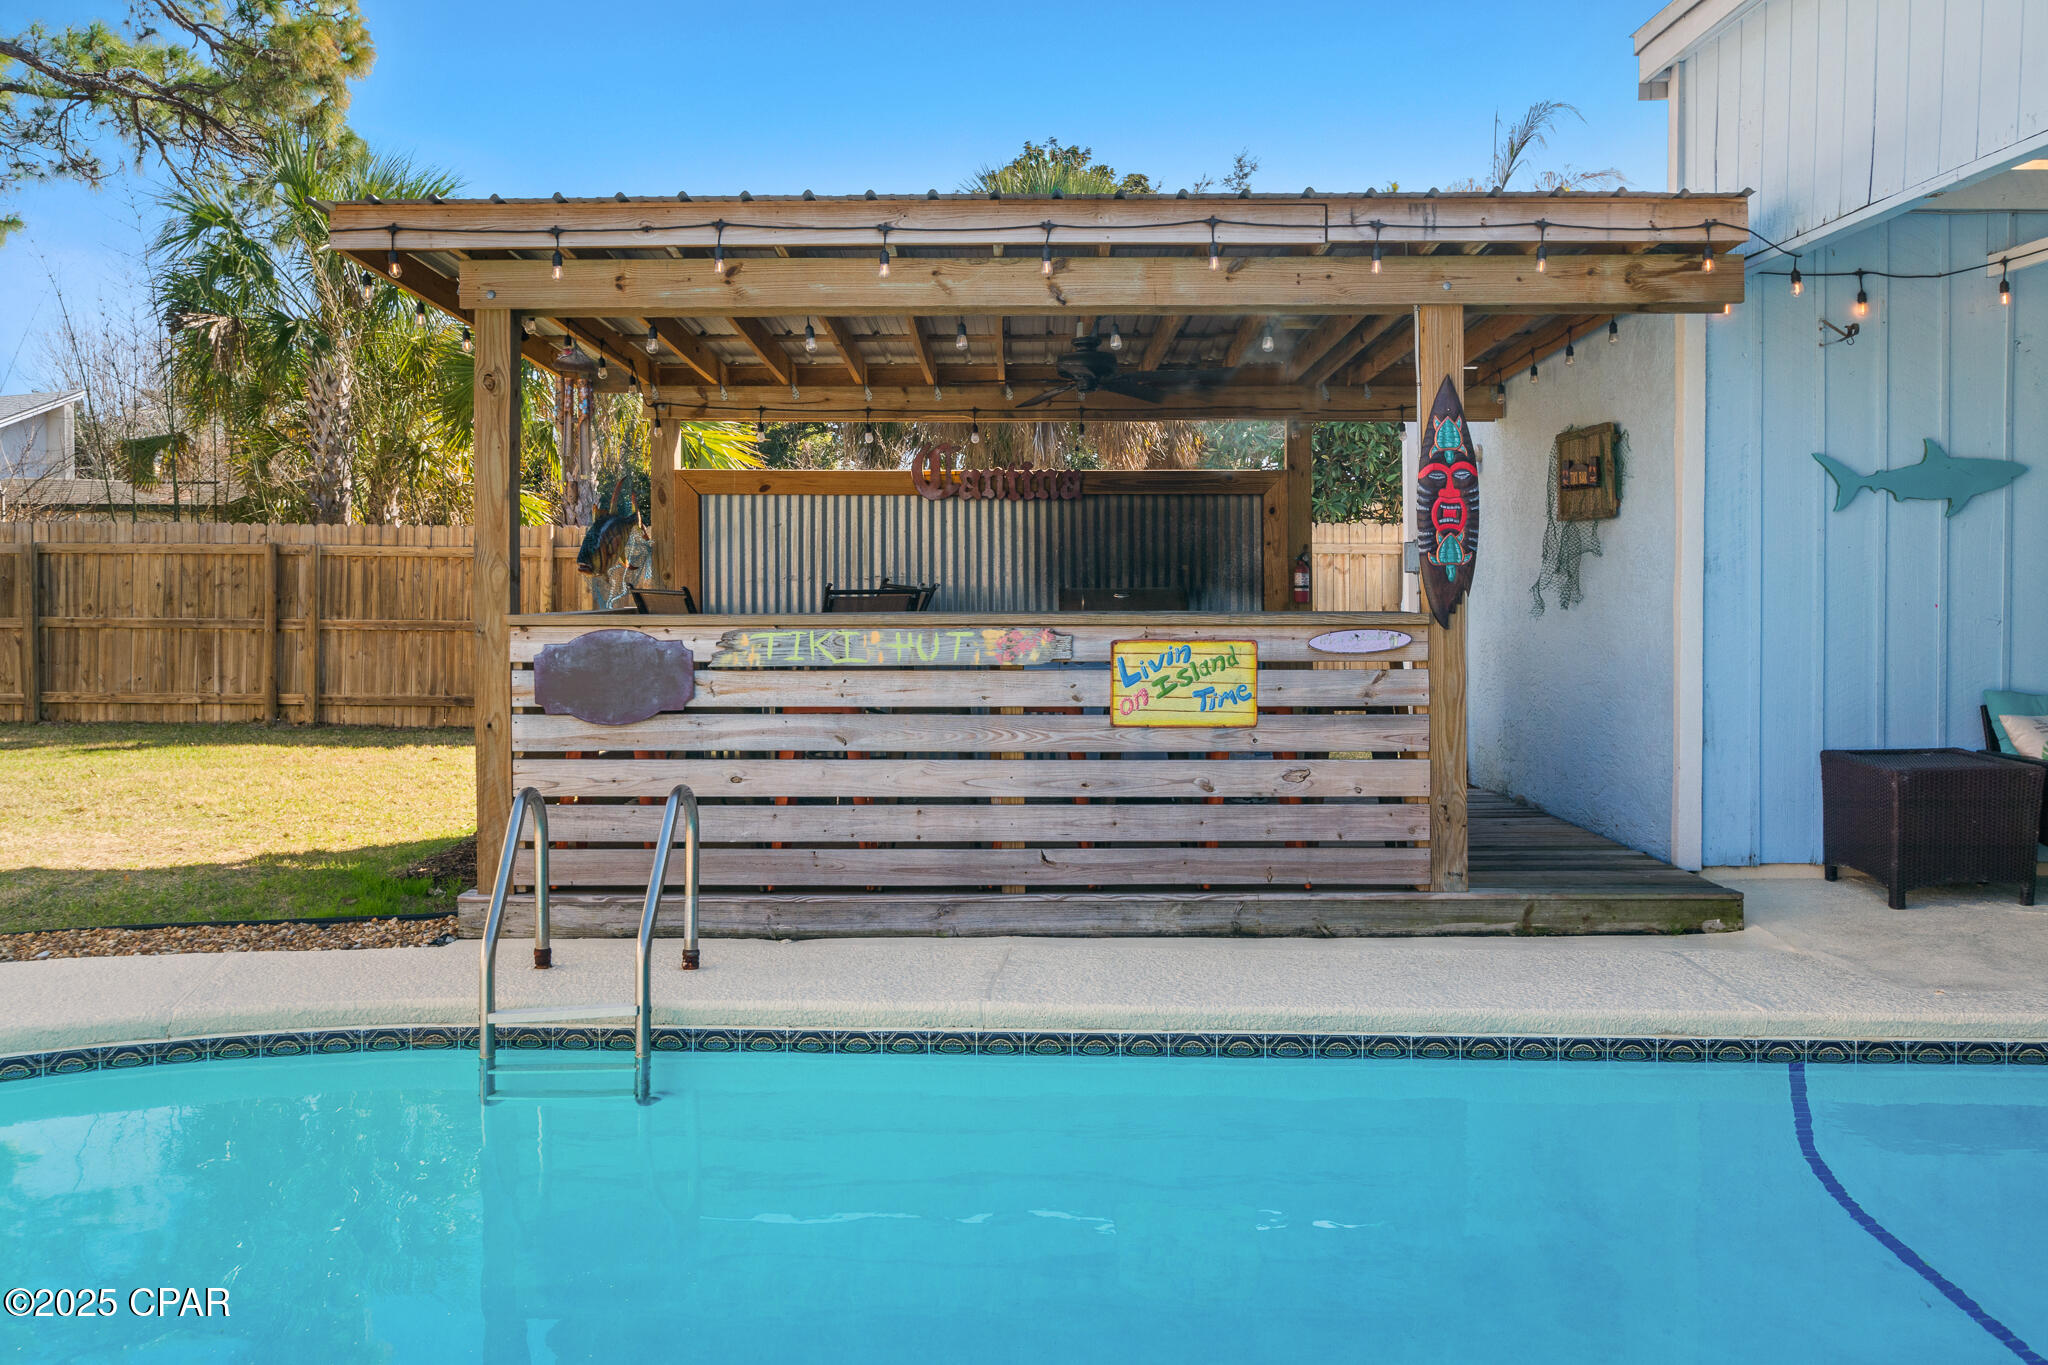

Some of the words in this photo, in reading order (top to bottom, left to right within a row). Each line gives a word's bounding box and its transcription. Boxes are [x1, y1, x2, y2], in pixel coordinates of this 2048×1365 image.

[911, 443, 1083, 500] Cantina
[750, 631, 868, 664] TIKI
[885, 632, 975, 662] HUT
[1117, 645, 1192, 688] Livin
[1151, 645, 1239, 699] Island
[1192, 684, 1252, 712] Time
